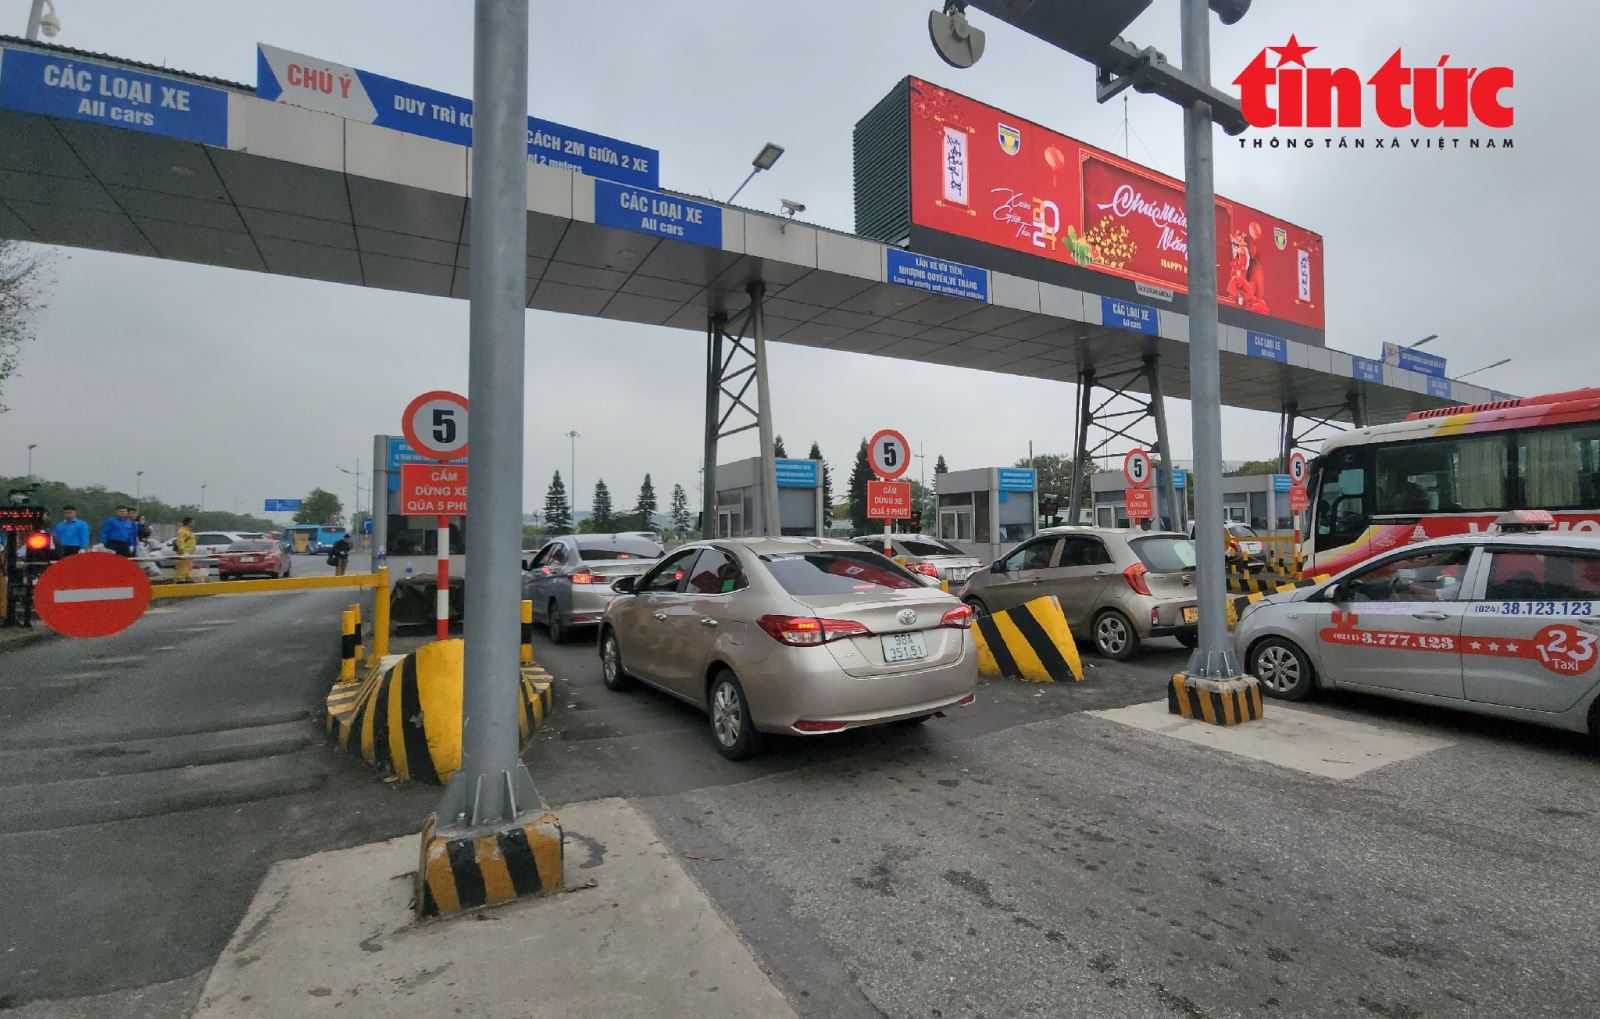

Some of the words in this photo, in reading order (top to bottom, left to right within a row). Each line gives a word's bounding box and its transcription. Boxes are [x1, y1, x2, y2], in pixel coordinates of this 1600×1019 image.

[44, 64, 92, 92] CÁC
[100, 74, 151, 106] LOẠI
[161, 86, 190, 112] XE
[287, 64, 333, 95] CHÚ
[338, 73, 352, 98] Ý
[78, 98, 105, 117] All
[111, 106, 154, 126] cars
[394, 95, 426, 116] DUY
[431, 104, 456, 124] TRÌ
[564, 140, 585, 157] 2M
[589, 145, 618, 166] GIỮA
[621, 154, 629, 168] 2
[633, 158, 648, 173] XE
[620, 191, 648, 213] CÁC
[652, 199, 681, 222] LOẠI
[686, 207, 702, 225] XE
[641, 217, 657, 231] All
[660, 221, 684, 236] cars
[930, 261, 938, 270] XE
[433, 409, 456, 443] 5
[884, 442, 896, 467] 5
[1134, 458, 1142, 478] 5
[1296, 461, 1302, 477] 5
[415, 484, 451, 496] DỪNG
[438, 502, 444, 510] 5
[895, 497, 903, 505] XE
[1475, 605, 1500, 614] (024)
[1502, 602, 1592, 615] 38.123.123
[1362, 632, 1454, 650] 3.777.123
[1536, 630, 1598, 662] 123
[1552, 659, 1578, 671] Taxi
